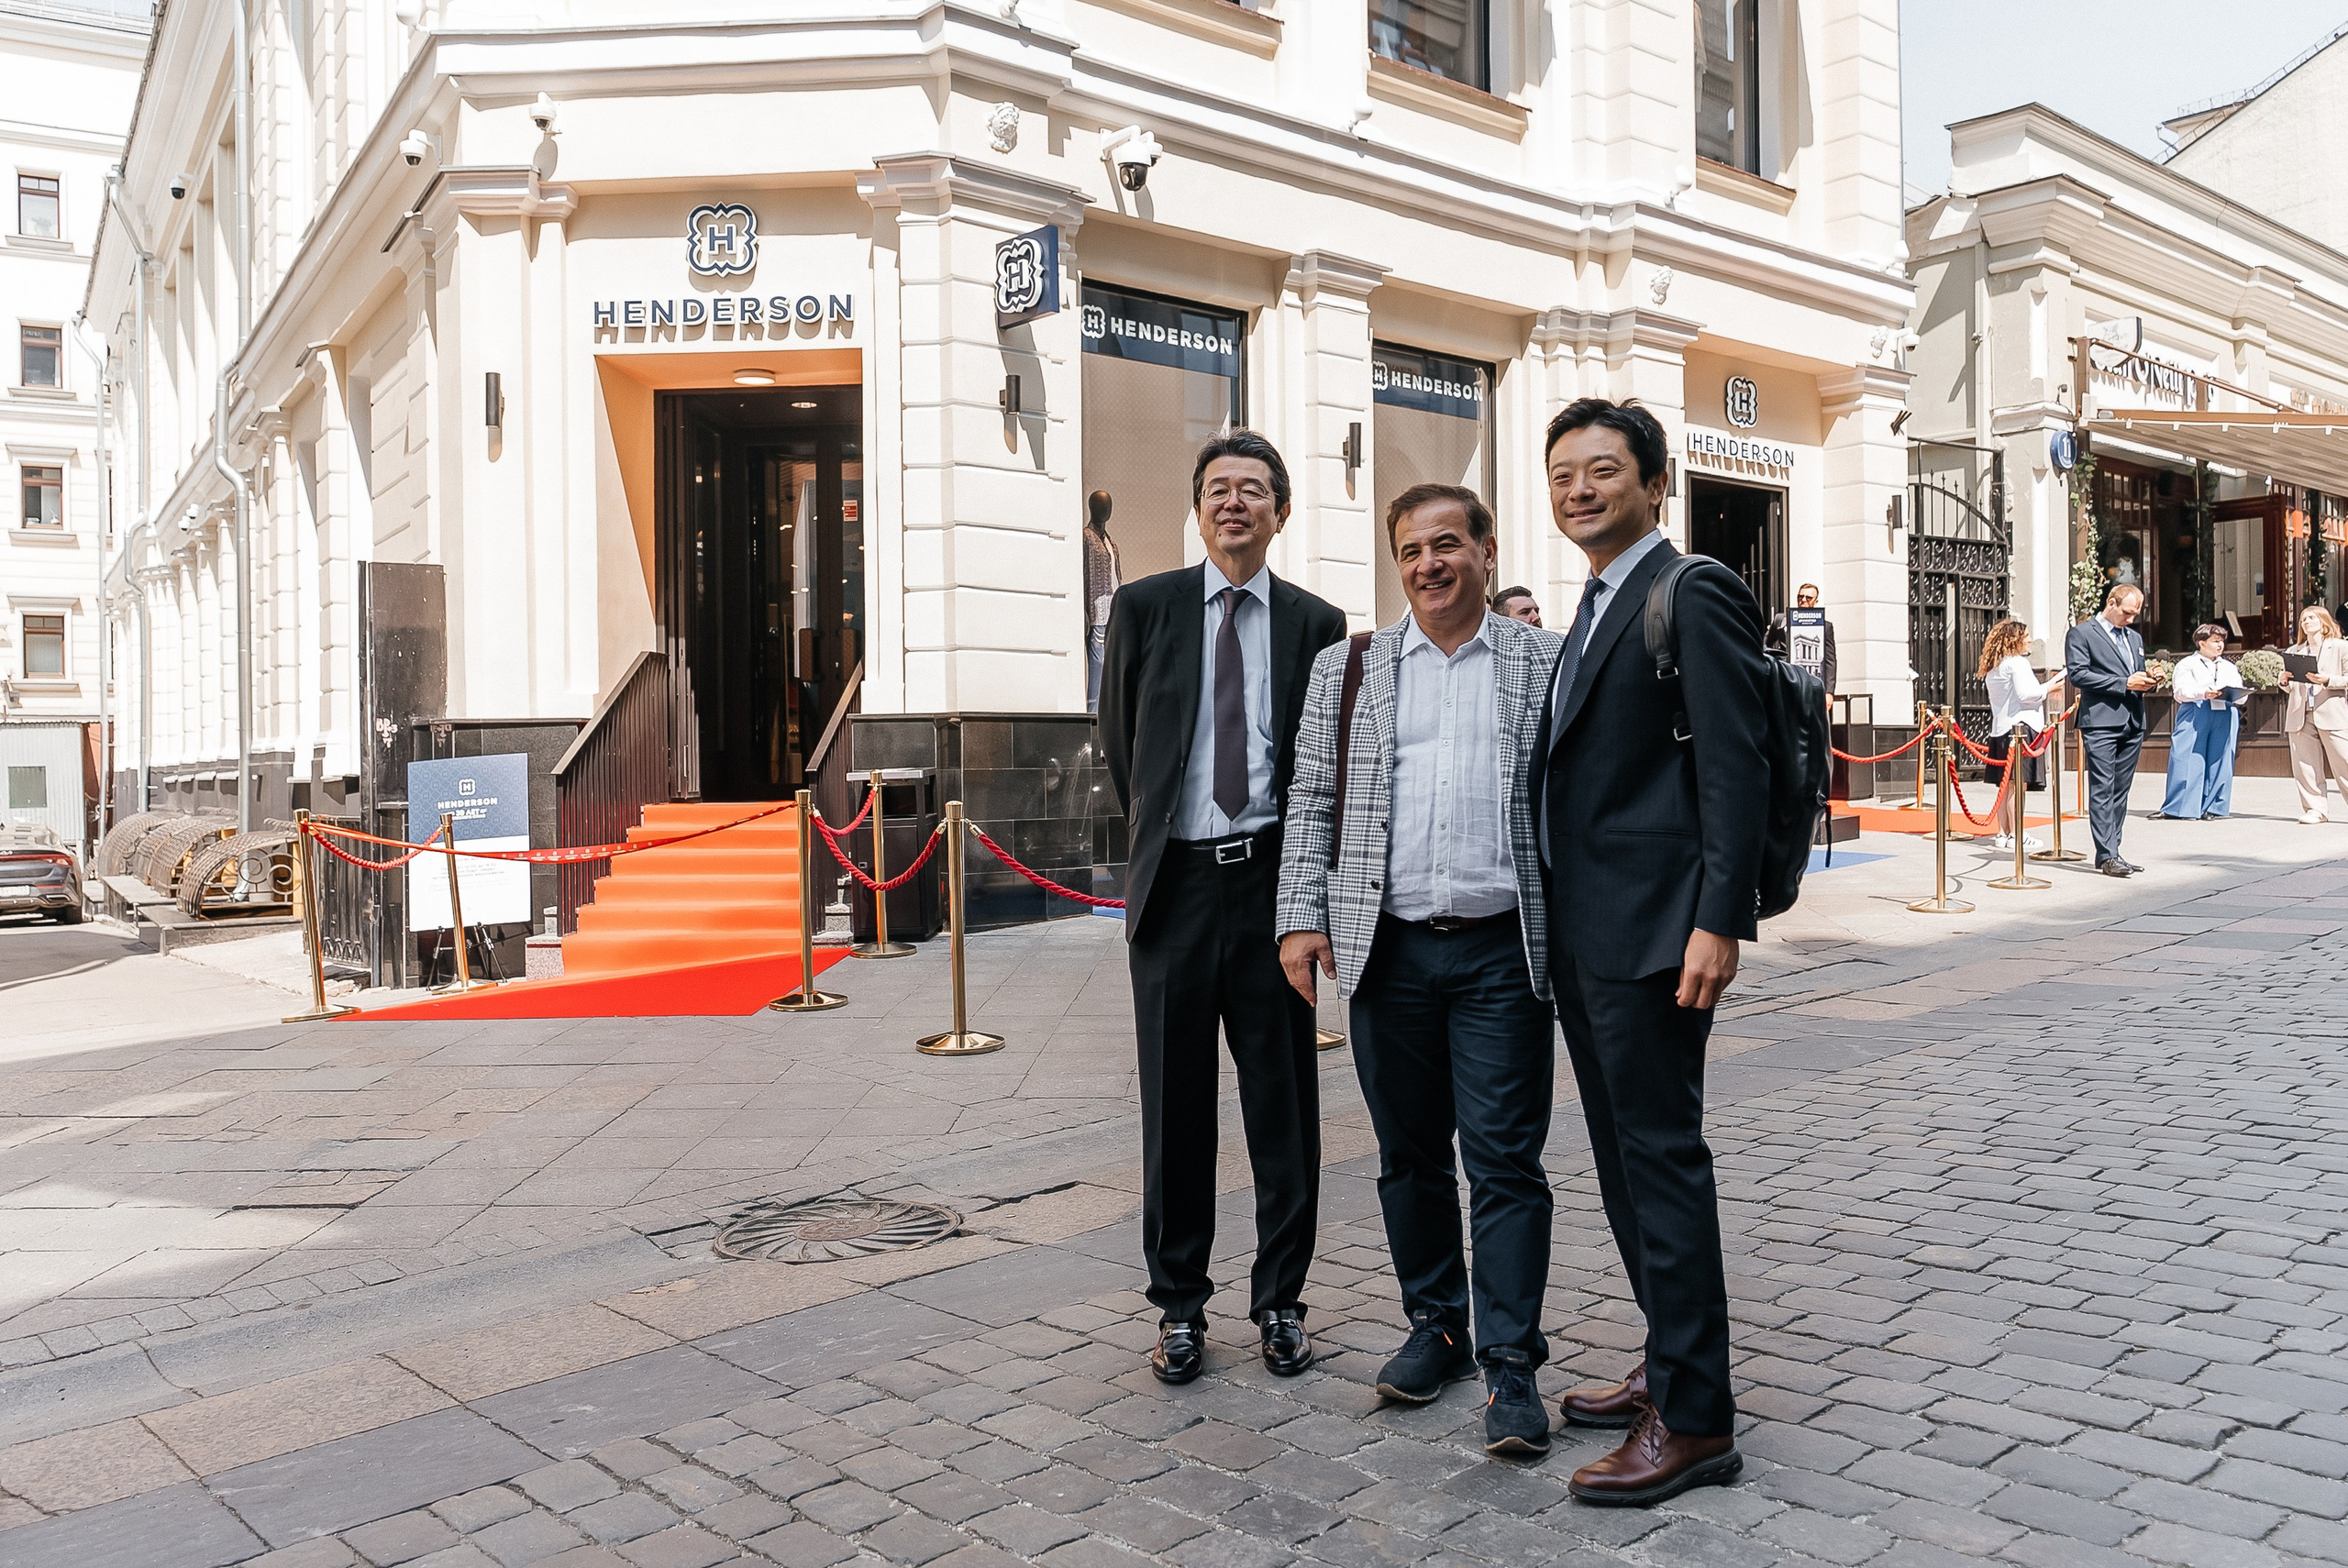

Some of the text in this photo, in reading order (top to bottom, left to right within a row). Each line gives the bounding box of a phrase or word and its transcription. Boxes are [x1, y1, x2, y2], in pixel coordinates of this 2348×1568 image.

[707, 224, 737, 254] H
[1006, 258, 1029, 292] H
[593, 294, 853, 327] HENDERSON
[1086, 313, 1233, 356] H HENDERSON
[1391, 370, 1484, 402] HENDERSON
[1735, 392, 1752, 414] H
[1689, 432, 1795, 467] HENDERSON
[437, 797, 498, 810] HENDERSON
